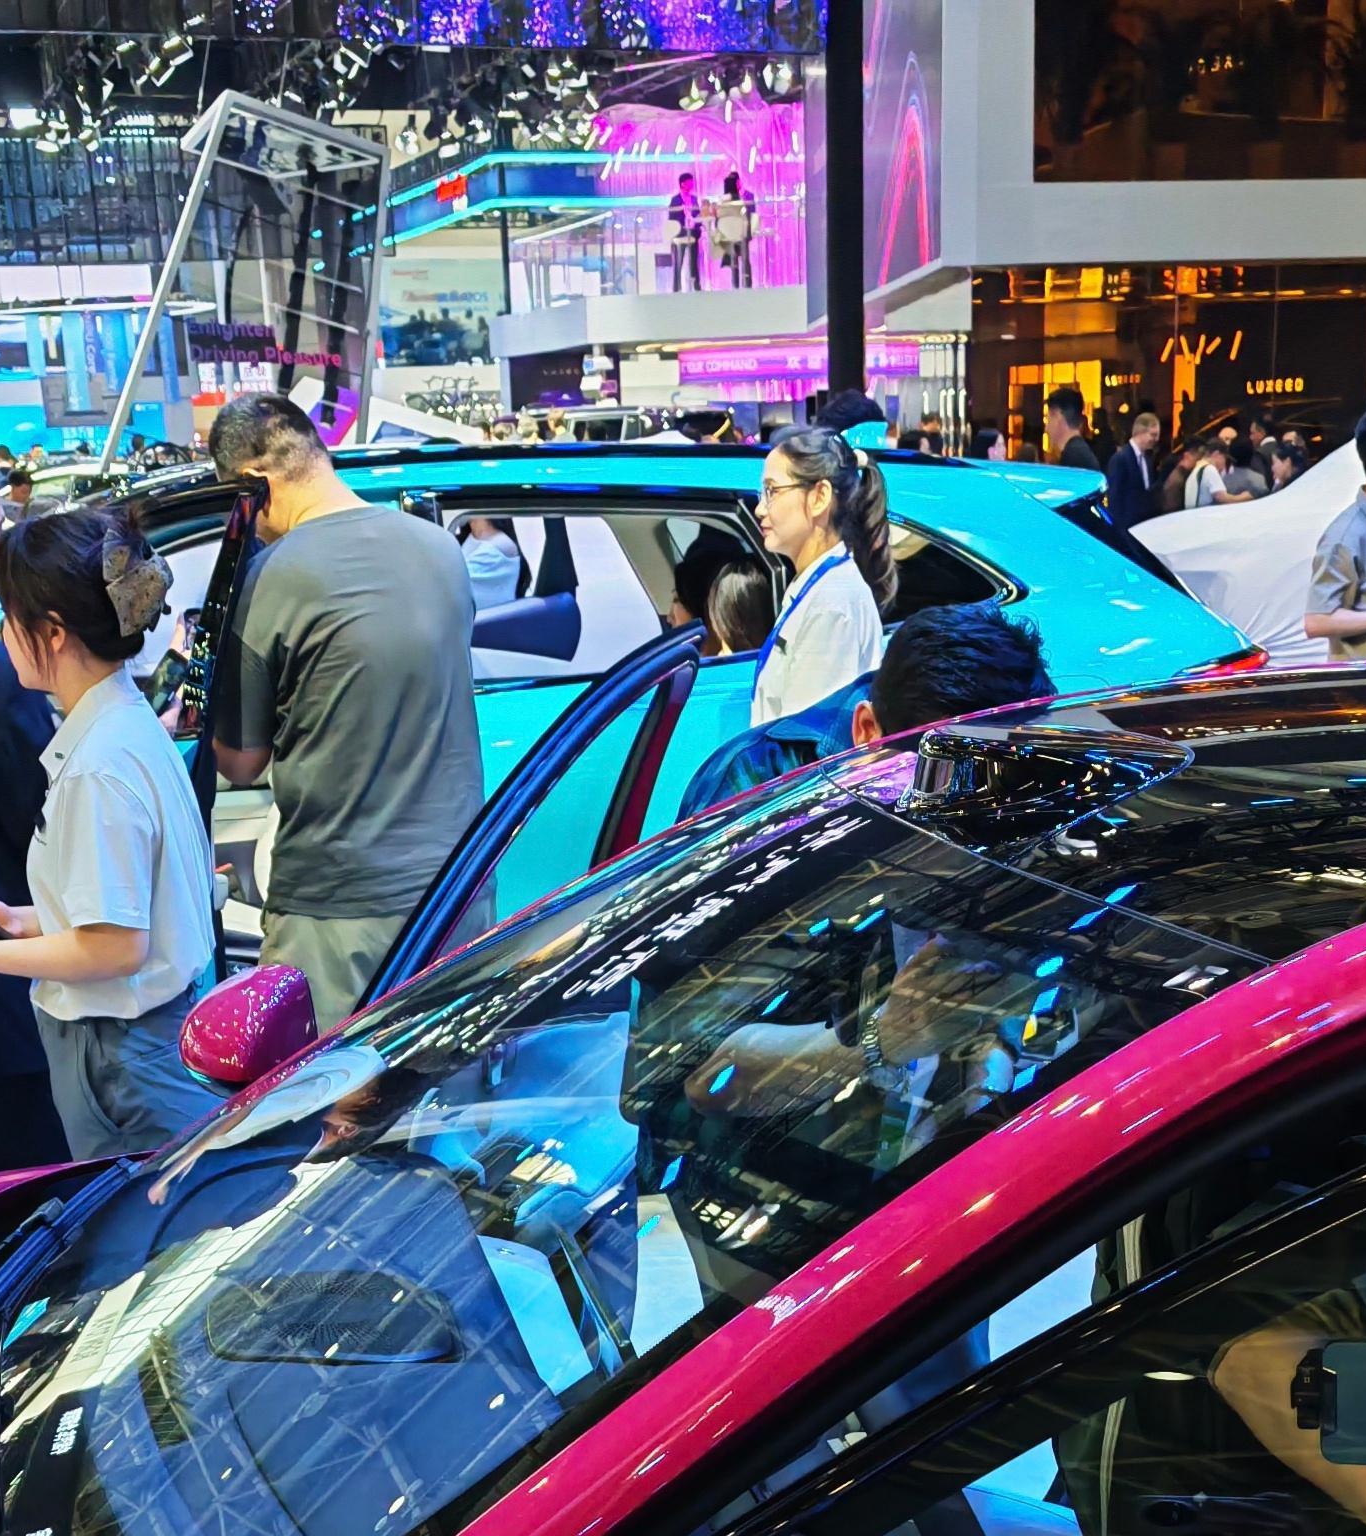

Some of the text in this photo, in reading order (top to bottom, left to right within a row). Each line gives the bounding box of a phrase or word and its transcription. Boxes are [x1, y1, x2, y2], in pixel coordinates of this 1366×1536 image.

[187, 318, 276, 341] Enlighten
[190, 344, 343, 367] Driving Pleasure
